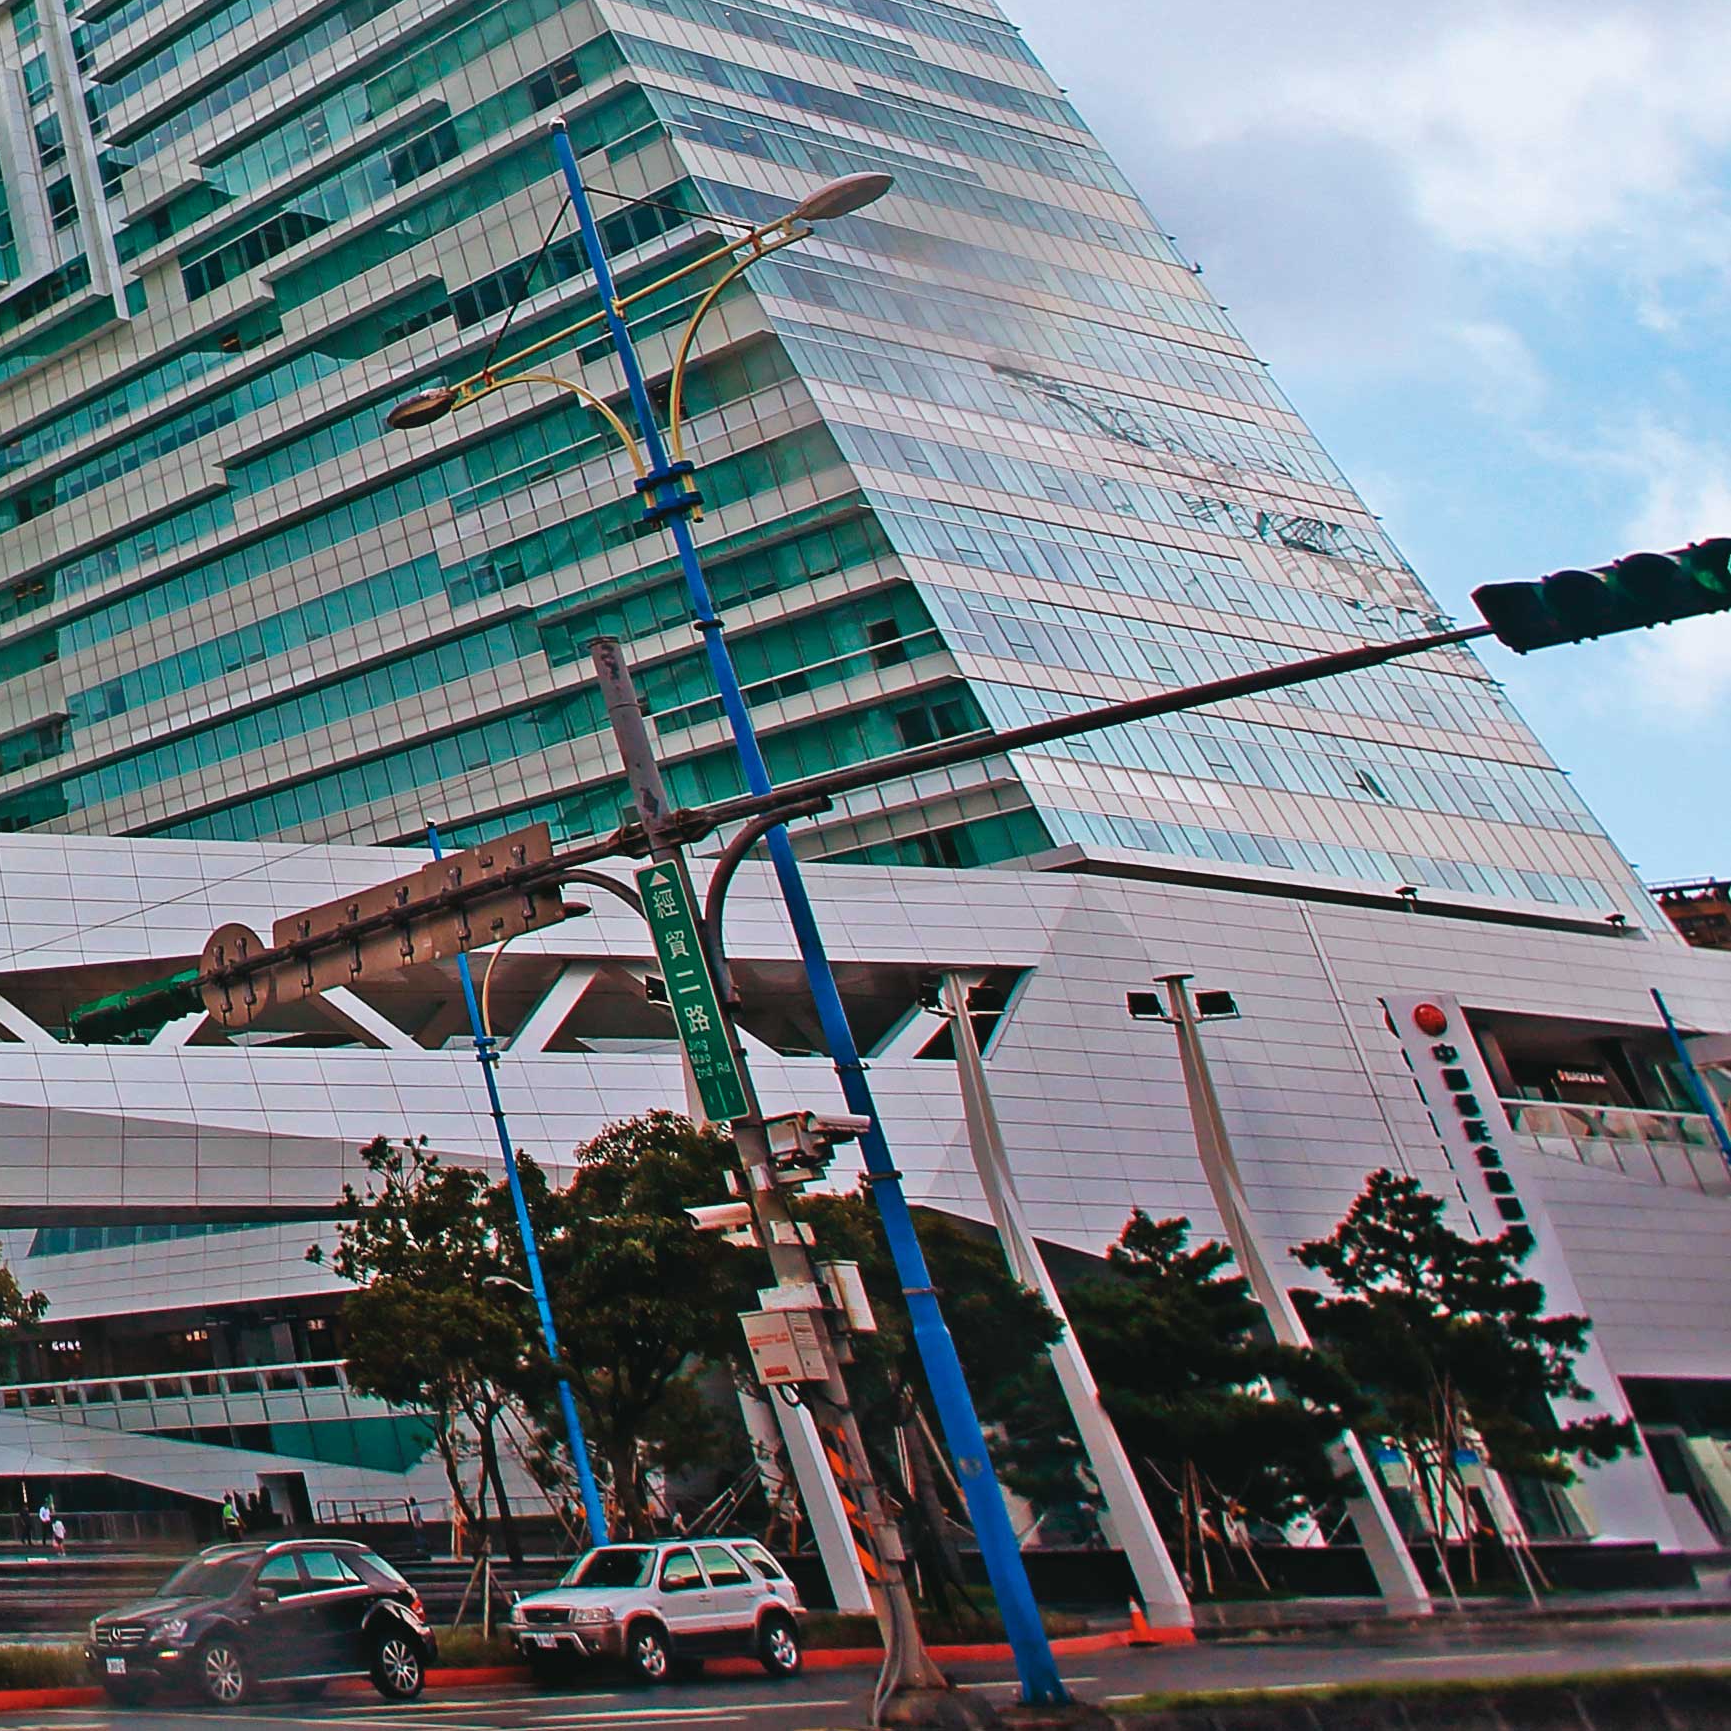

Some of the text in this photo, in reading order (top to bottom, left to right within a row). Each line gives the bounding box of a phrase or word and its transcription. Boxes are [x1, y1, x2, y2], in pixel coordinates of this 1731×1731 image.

[651, 888, 712, 1034] 經貿二路
[716, 1061, 731, 1075] Rd
